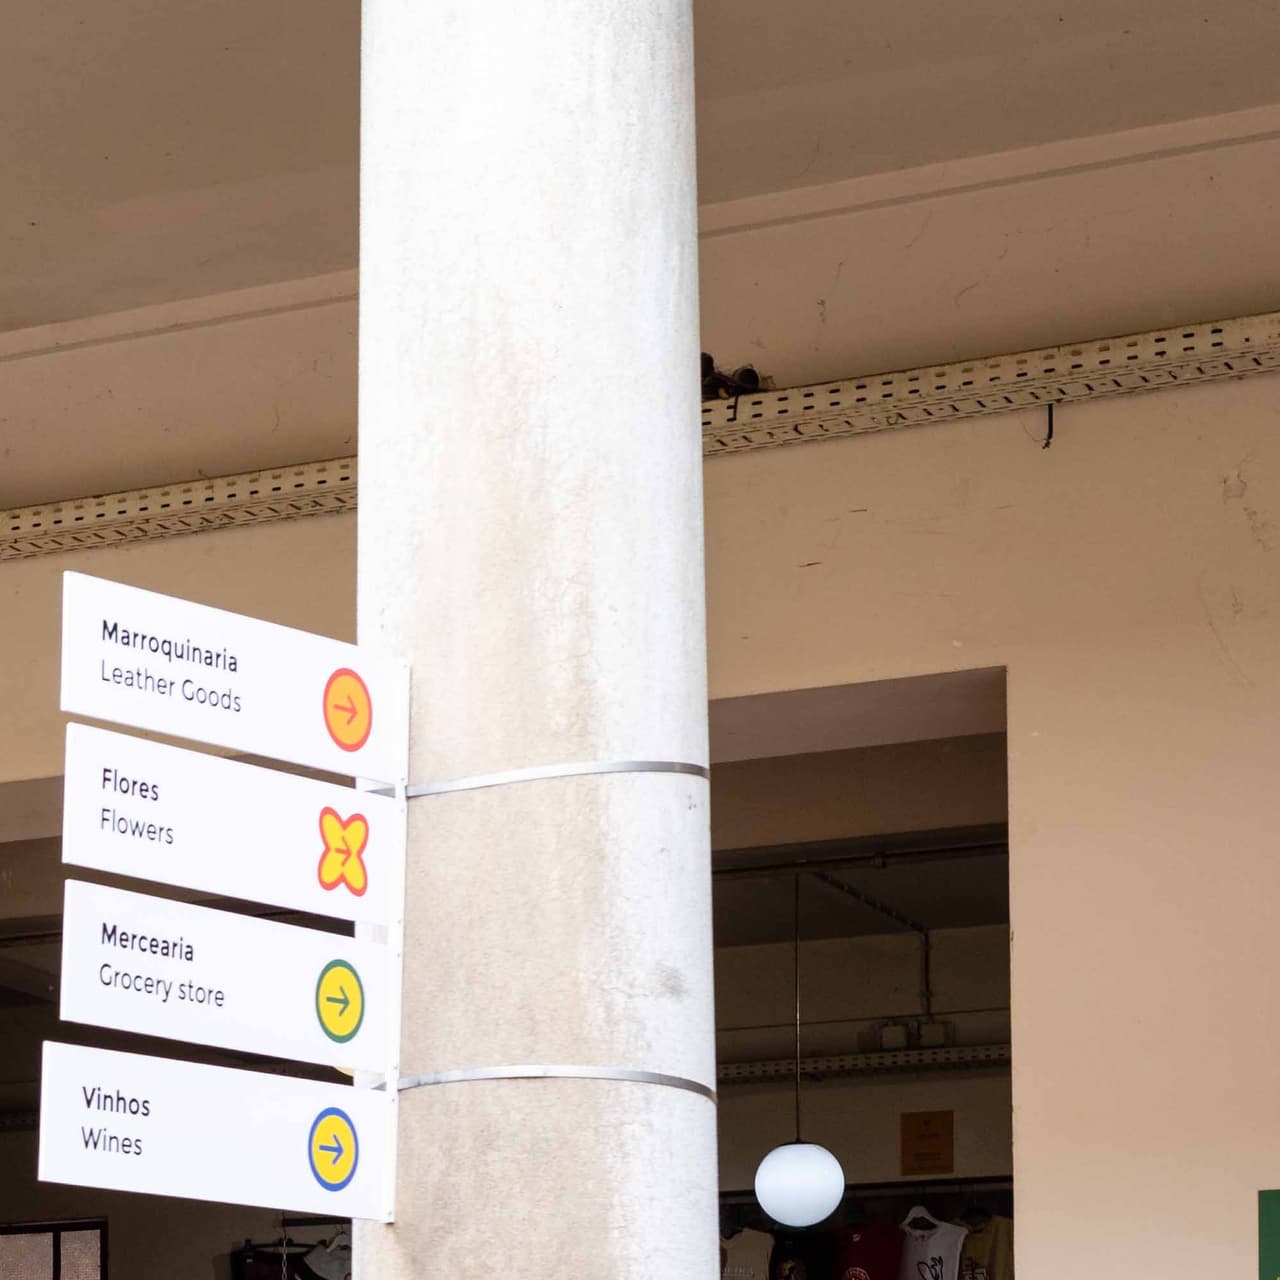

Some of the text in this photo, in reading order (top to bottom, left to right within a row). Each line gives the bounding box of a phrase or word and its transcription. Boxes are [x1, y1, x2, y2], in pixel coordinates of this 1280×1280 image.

[101, 619, 240, 674] Marroquinaria
[100, 659, 242, 714] Leather Goods
[101, 767, 161, 802] Flores
[100, 807, 175, 846] Flowers
[101, 922, 195, 963] Mercearia
[99, 962, 226, 1009] Grocery store
[81, 1085, 152, 1119] Vinhos
[80, 1125, 144, 1158] Wines
